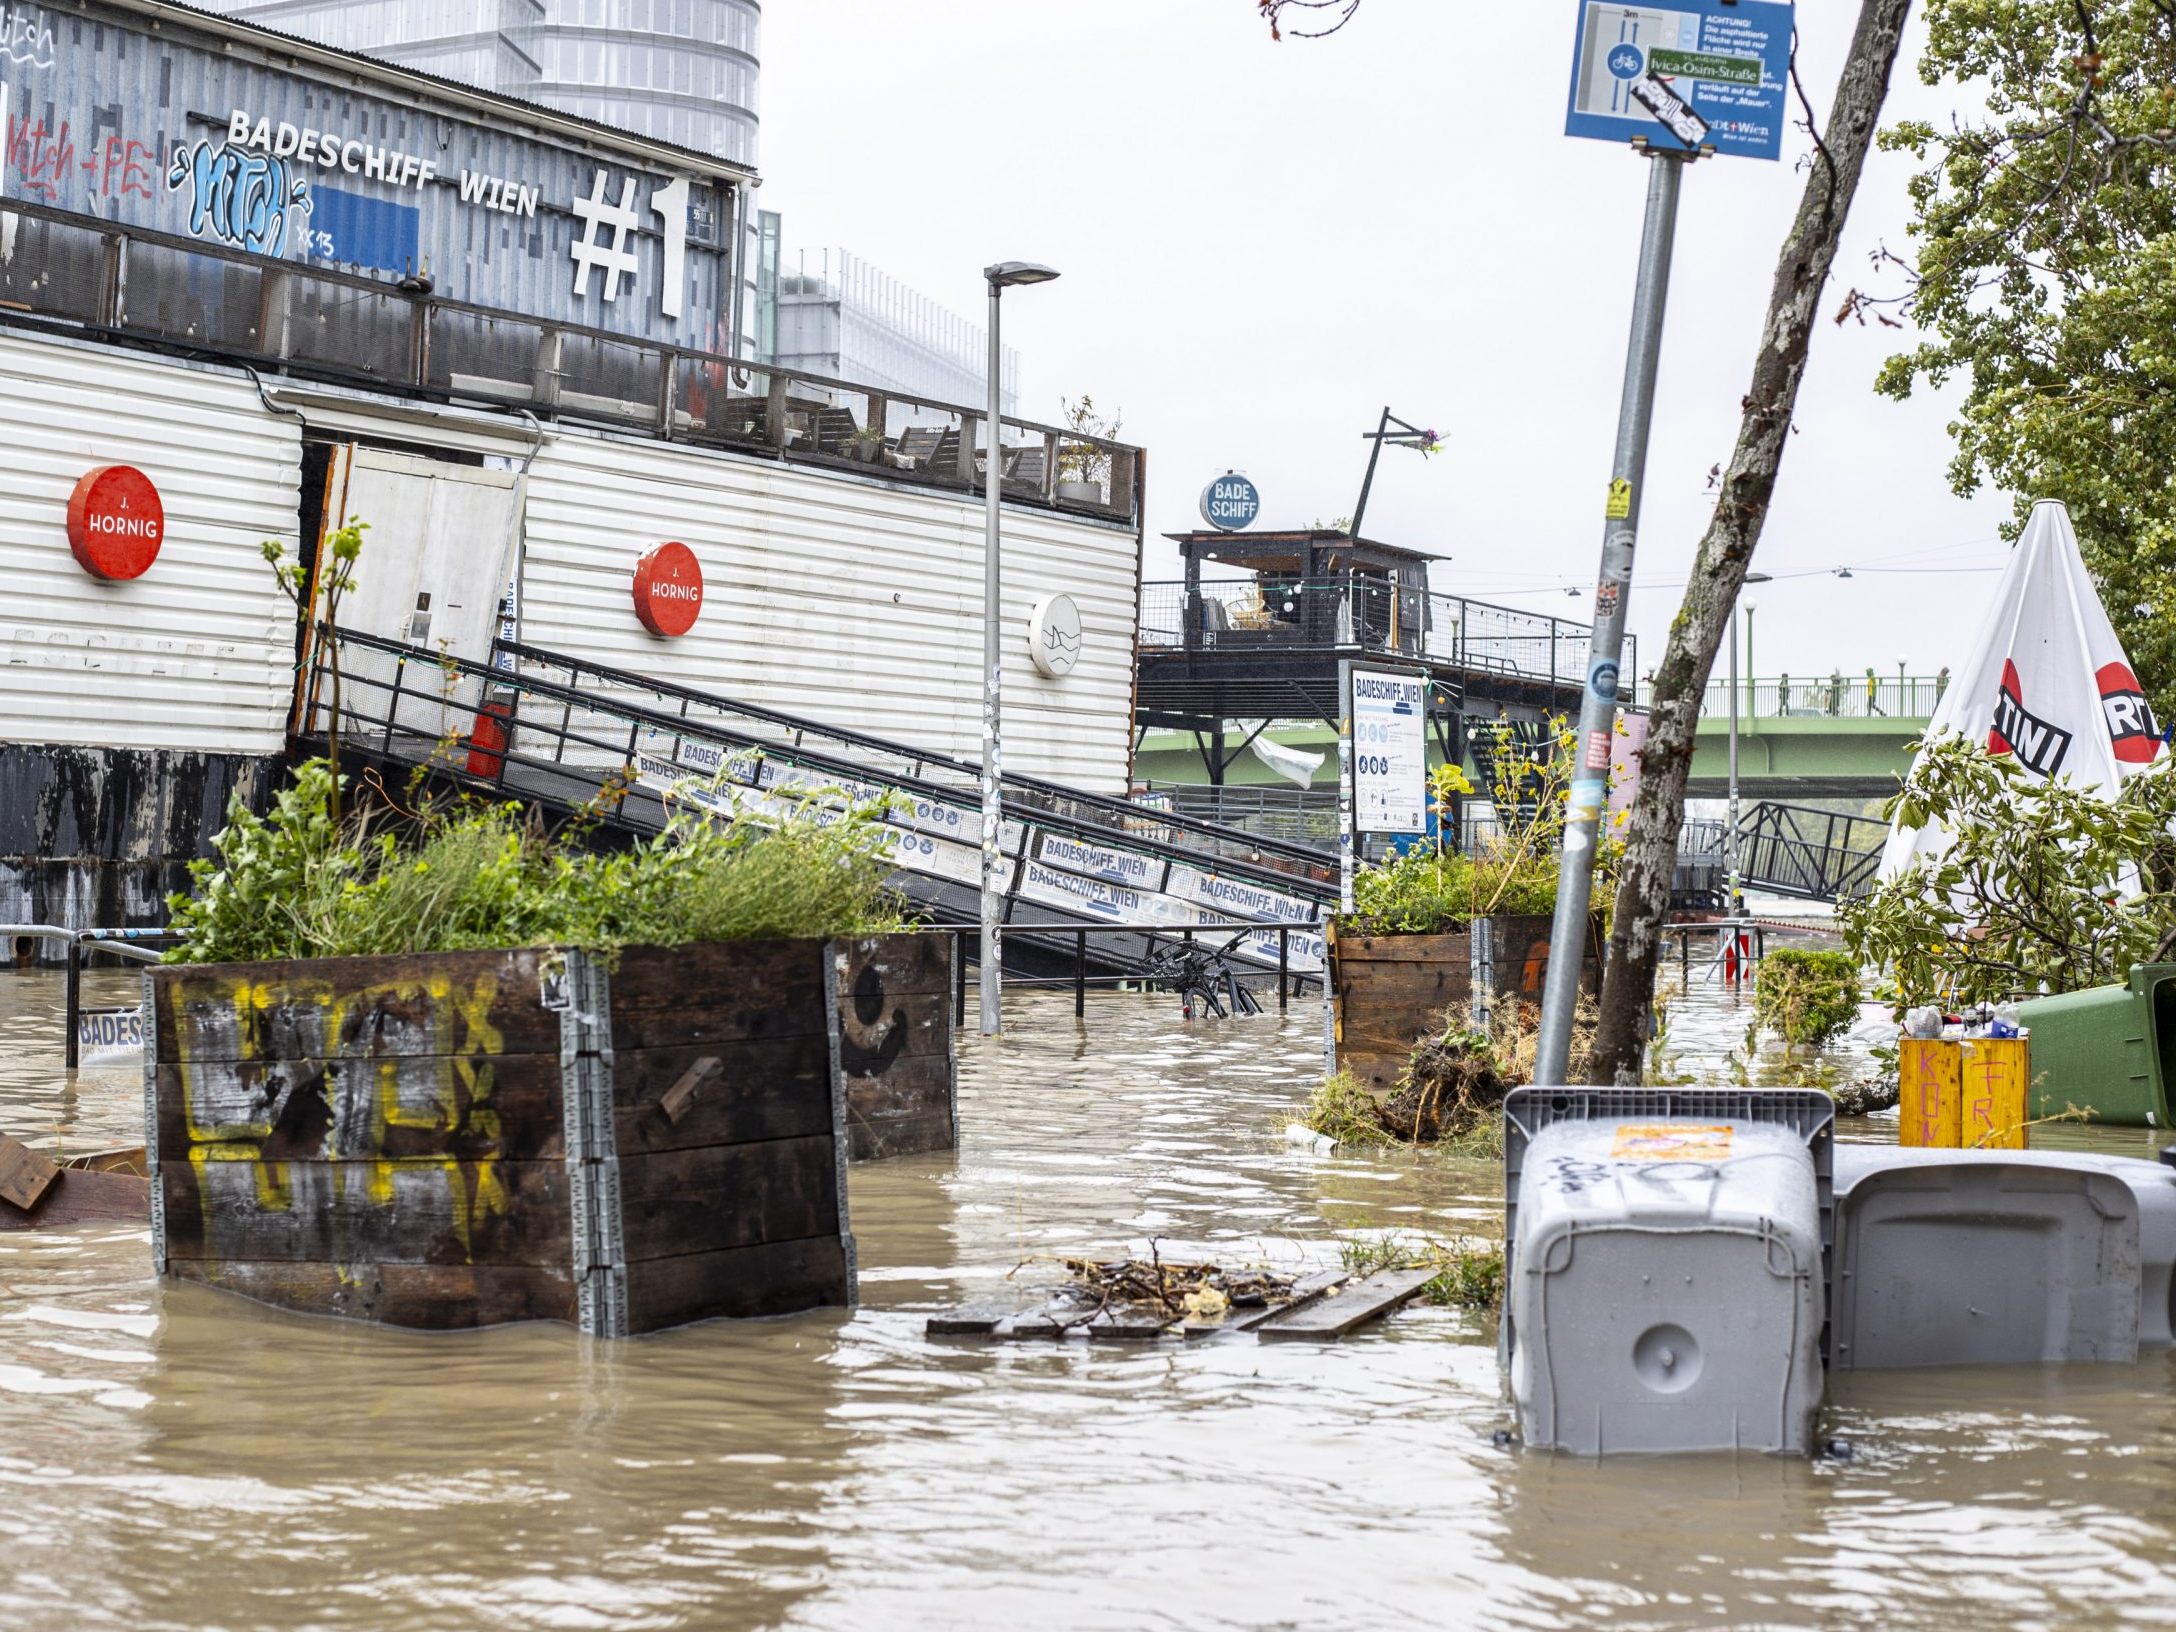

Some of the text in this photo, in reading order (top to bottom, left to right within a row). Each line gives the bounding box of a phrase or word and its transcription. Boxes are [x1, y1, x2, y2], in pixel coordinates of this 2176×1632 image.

[1623, 9, 1639, 19] 3m
[1705, 15, 1752, 28] ACHTUNG!
[1705, 24, 1769, 40] Die asphaltierte
[1704, 34, 1767, 49] Fläche wird nur
[1703, 44, 1760, 58] in einer Breite
[1650, 57, 1757, 81] Ivica-Osim-Straße
[1697, 91, 1719, 101] Seite
[1720, 94, 1735, 103] der
[1698, 83, 1760, 97] verläuft auf der
[228, 109, 539, 218] BADESCHIFF WIEN
[571, 169, 690, 318] #1
[1215, 482, 1251, 500] BADE
[120, 497, 129, 509] J.
[1211, 501, 1257, 518] SCHIFF
[89, 515, 157, 538] HORNIG
[672, 567, 680, 578] J.
[651, 581, 698, 601] HORNIG
[1356, 678, 1422, 703] BADESCHIFF WIEN
[1045, 839, 1147, 876] BADESCHIFF WIEN
[1028, 865, 1139, 910] BADESCHIFF WIEN
[1200, 877, 1305, 921] BADESCHIFF WIEN
[80, 1016, 142, 1046] BADES
